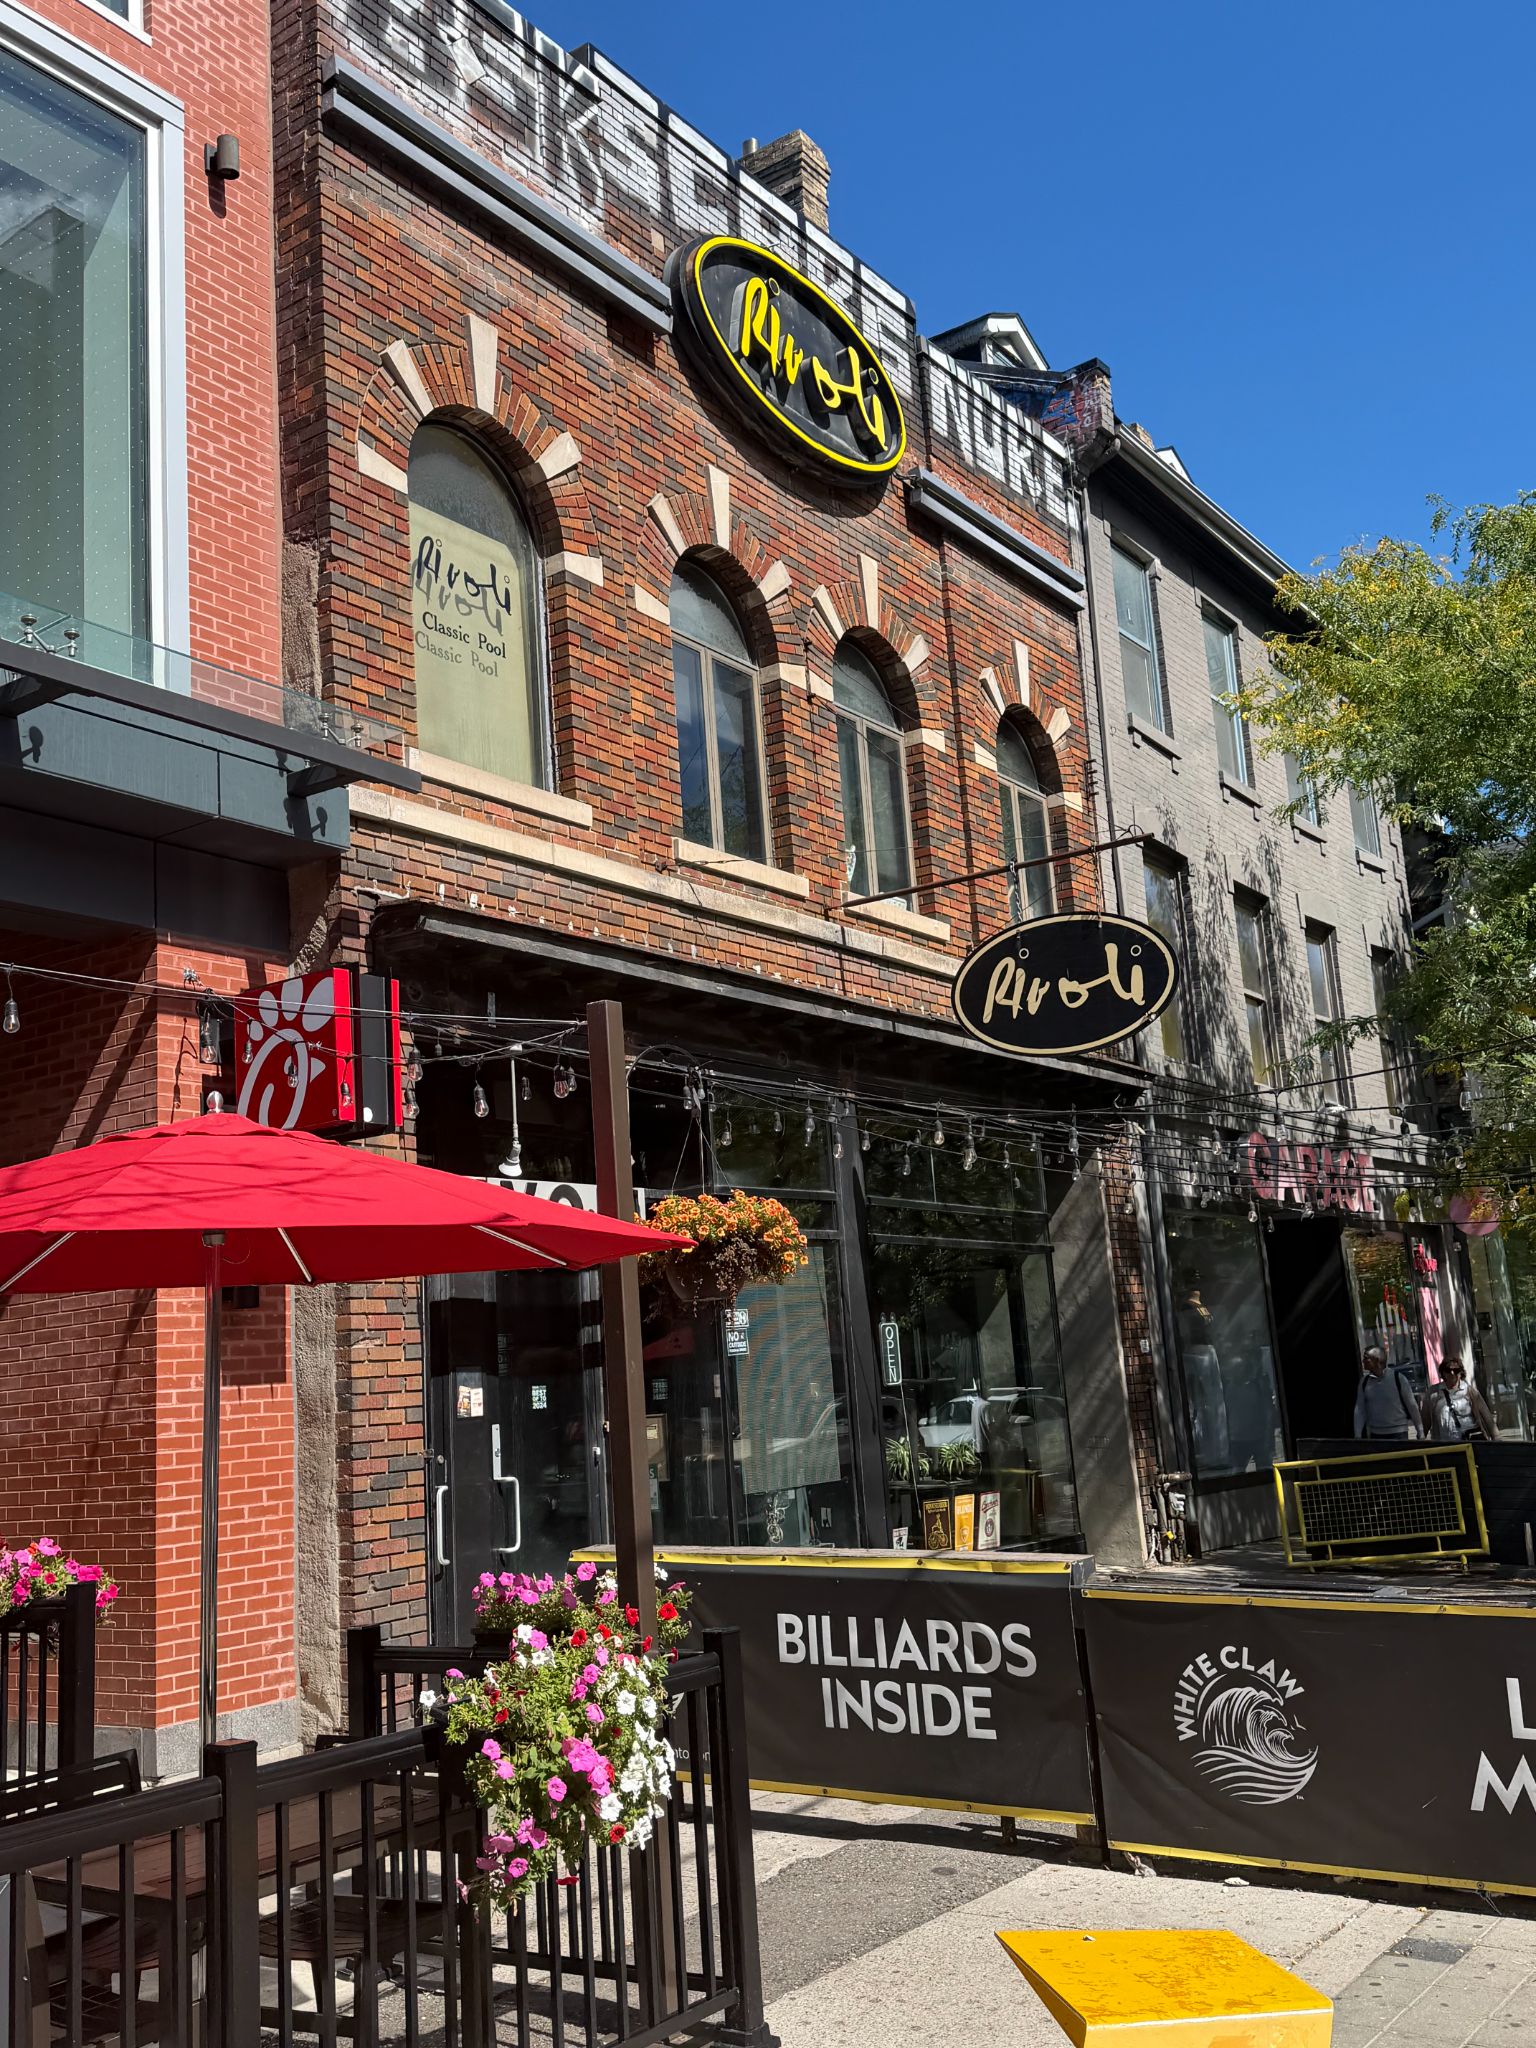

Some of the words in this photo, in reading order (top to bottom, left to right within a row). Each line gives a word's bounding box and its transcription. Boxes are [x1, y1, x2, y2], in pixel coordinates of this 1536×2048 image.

[741, 277, 888, 451] Rivoli
[416, 535, 511, 616] Rivoli
[422, 611, 470, 644] Classic
[478, 632, 506, 658] Pool
[983, 942, 1146, 1023] Rivoli
[728, 1331, 740, 1341] NO
[884, 1326, 897, 1382] OPEN
[776, 1613, 1037, 1677] BILLIARDS
[821, 1677, 997, 1740] INSIDE
[1173, 1652, 1218, 1741] WHITE
[1219, 1645, 1305, 1699] CLAW
